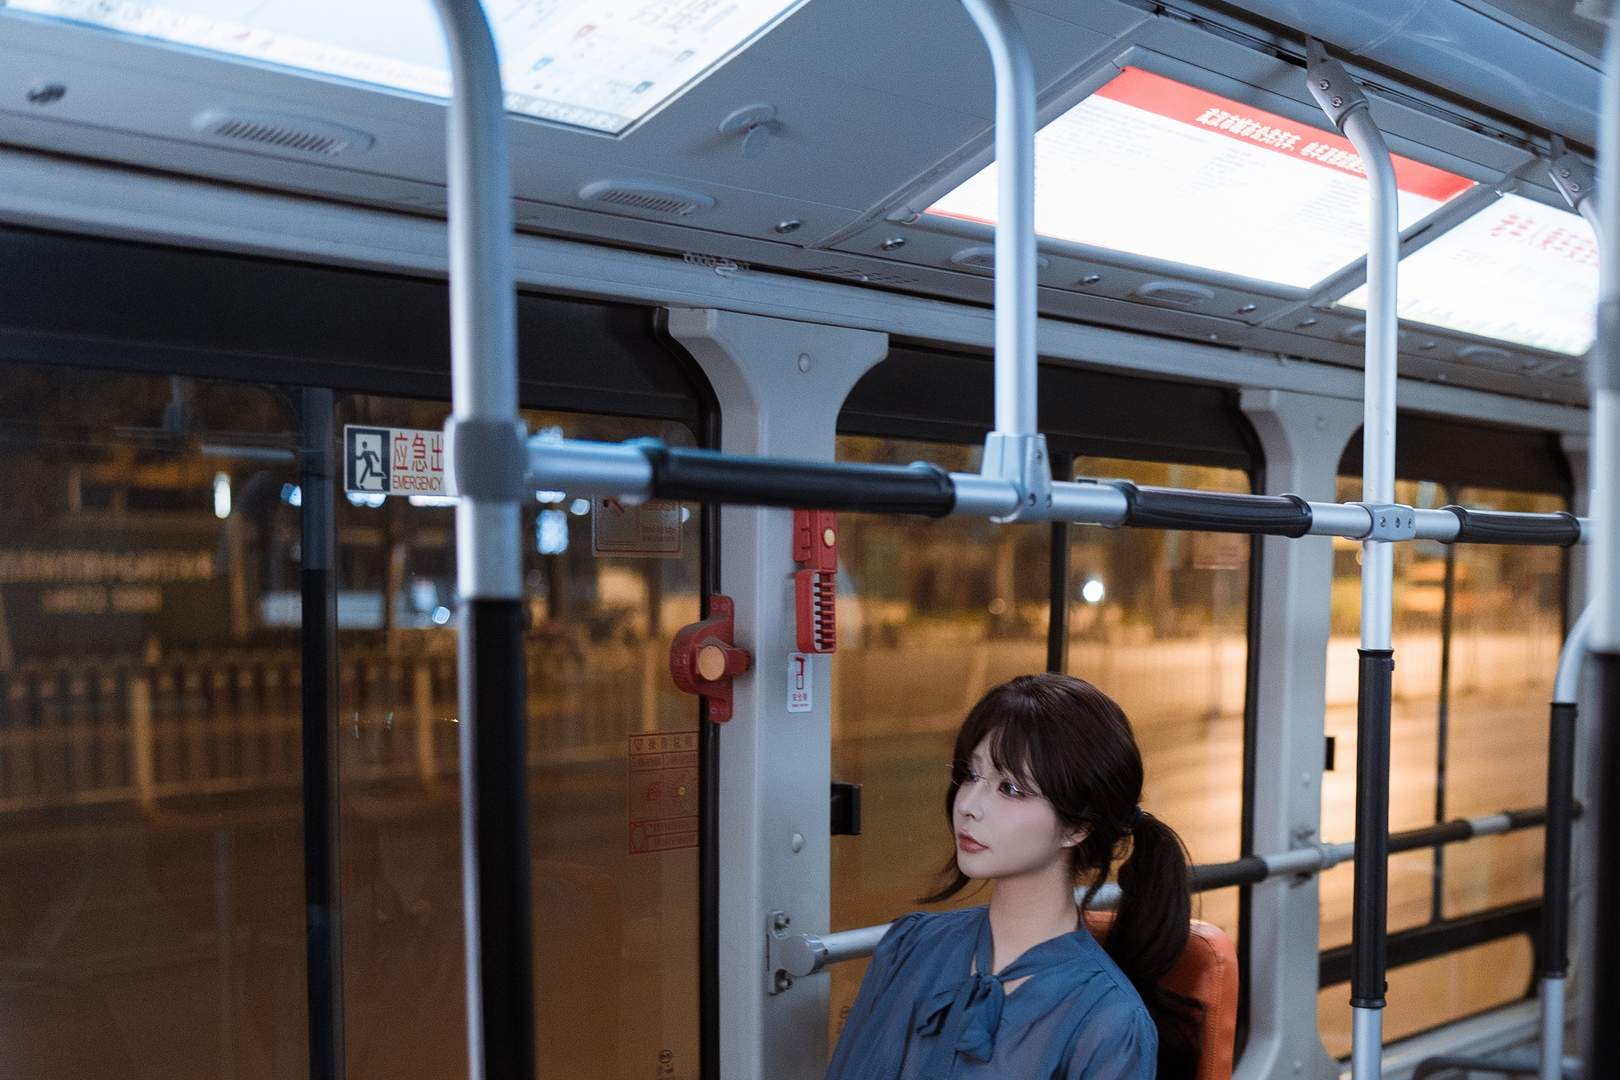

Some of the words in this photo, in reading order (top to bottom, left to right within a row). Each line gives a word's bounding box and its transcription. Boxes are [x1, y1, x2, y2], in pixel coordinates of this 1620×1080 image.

[393, 433, 444, 472] 应急出
[393, 475, 442, 491] EMERGENCY
